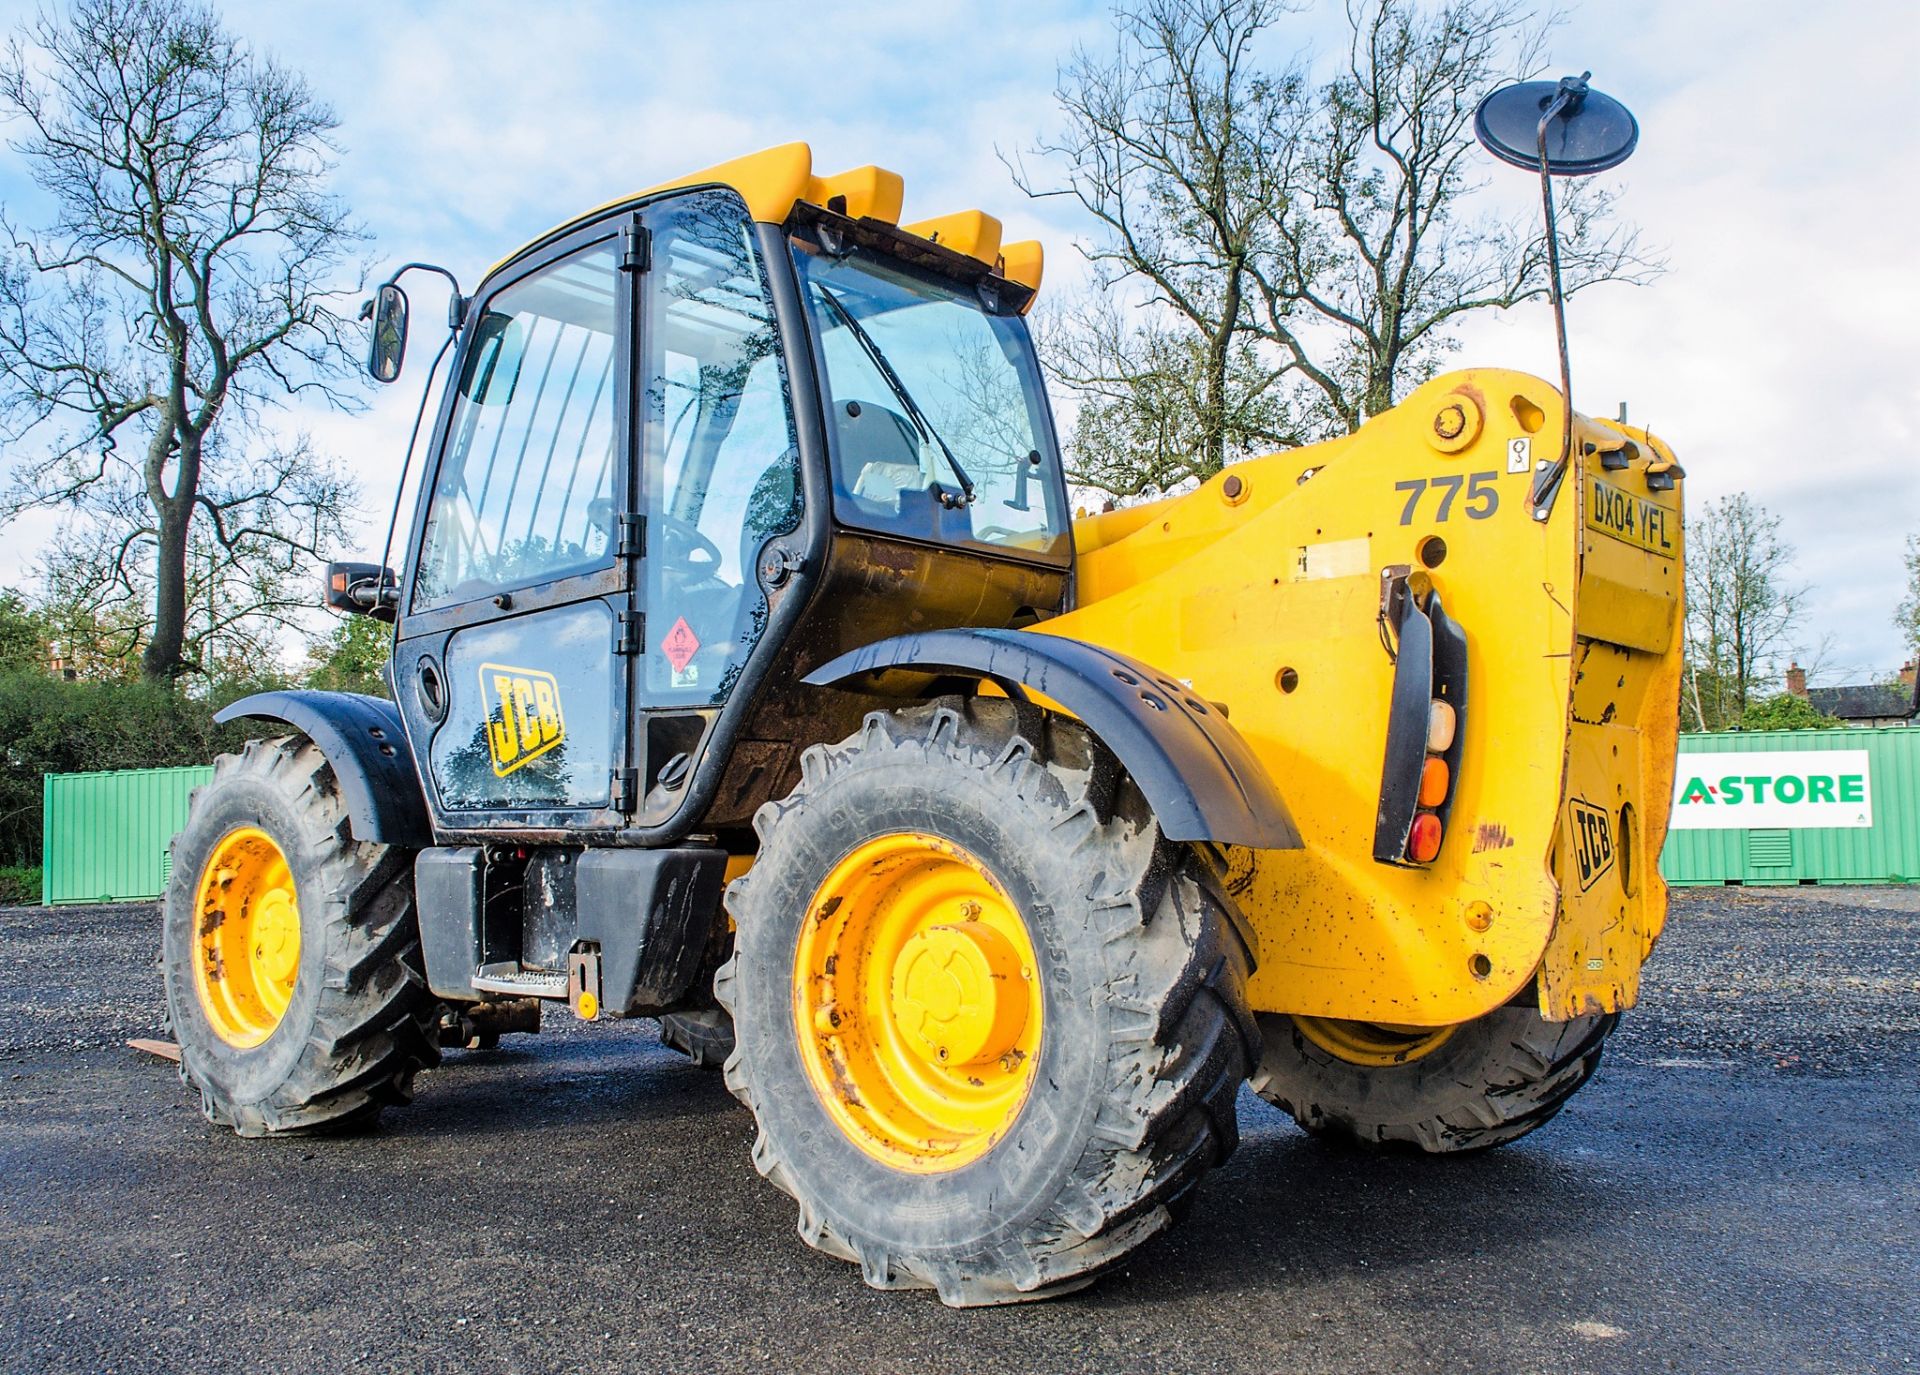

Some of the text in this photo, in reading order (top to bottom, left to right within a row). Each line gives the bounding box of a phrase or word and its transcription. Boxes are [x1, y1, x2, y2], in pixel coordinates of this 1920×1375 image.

[1395, 471, 1500, 526] 775
[1595, 482, 1671, 549] DX04 YFL
[493, 674, 559, 764] JCB
[1576, 808, 1611, 881] JCB
